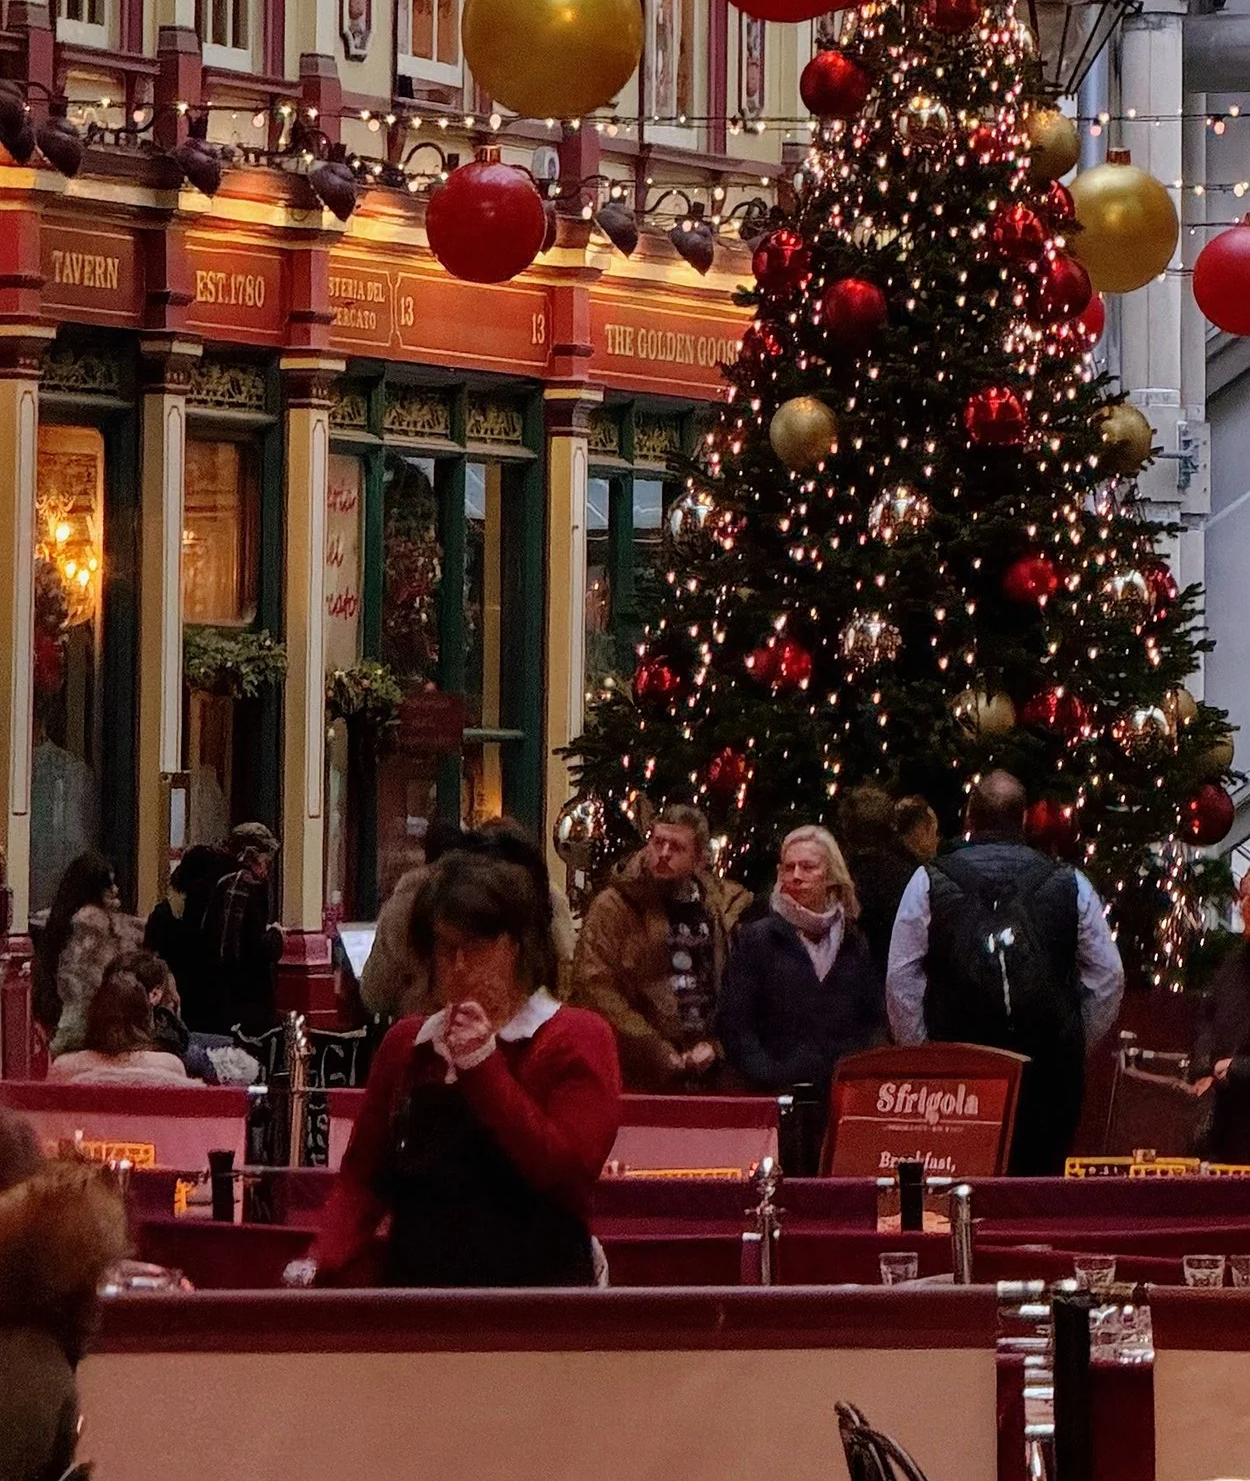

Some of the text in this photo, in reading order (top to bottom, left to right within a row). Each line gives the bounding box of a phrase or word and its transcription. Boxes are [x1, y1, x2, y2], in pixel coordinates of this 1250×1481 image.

[52, 250, 119, 290] TAVERN
[196, 270, 265, 308] EST.1780
[328, 276, 386, 303] STERIA DEL
[400, 296, 414, 327] 13
[531, 313, 546, 344] 13
[605, 324, 635, 357] THE
[637, 328, 694, 365] GOLDEN
